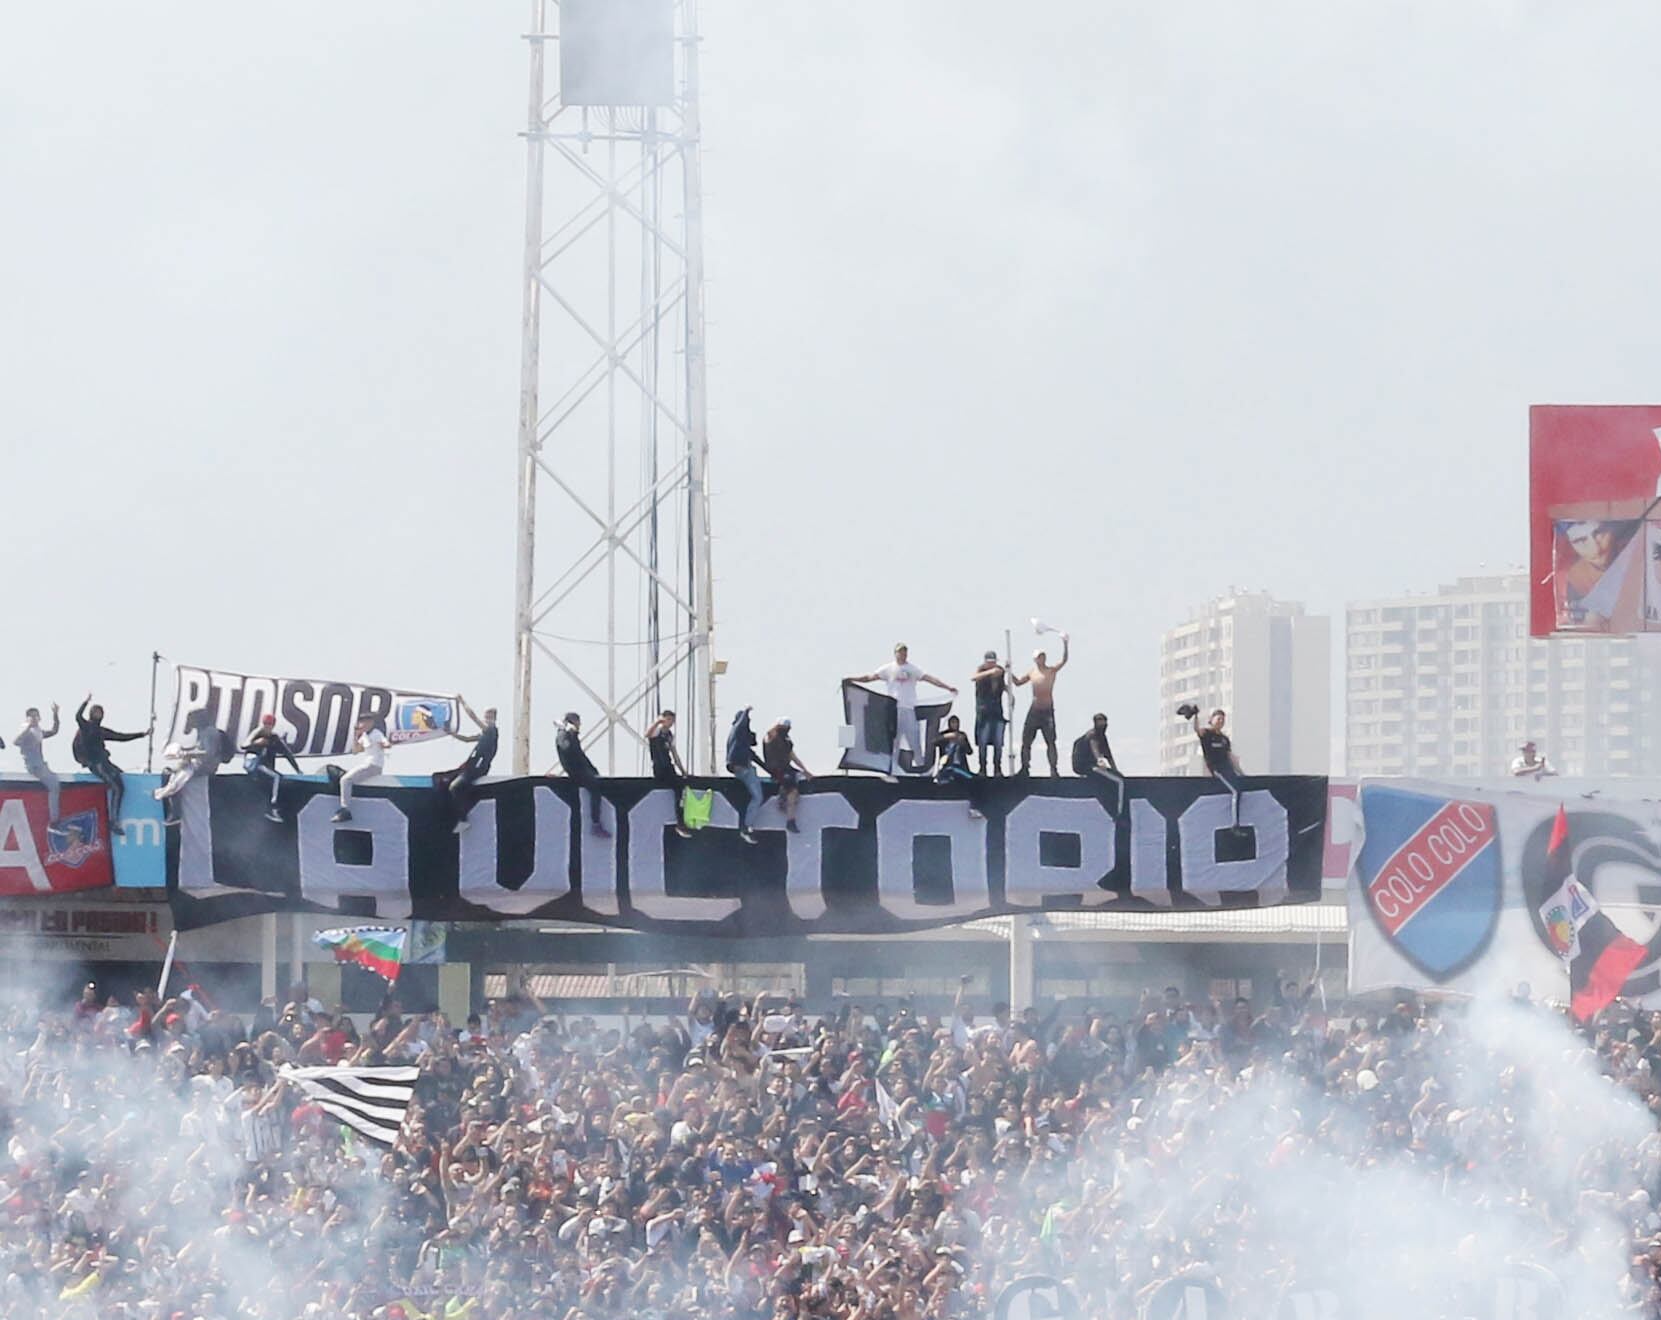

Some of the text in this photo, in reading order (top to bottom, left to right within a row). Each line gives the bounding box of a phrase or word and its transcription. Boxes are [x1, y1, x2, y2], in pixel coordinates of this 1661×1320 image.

[177, 775, 412, 919] LA
[1374, 801, 1487, 920] COLO COLO
